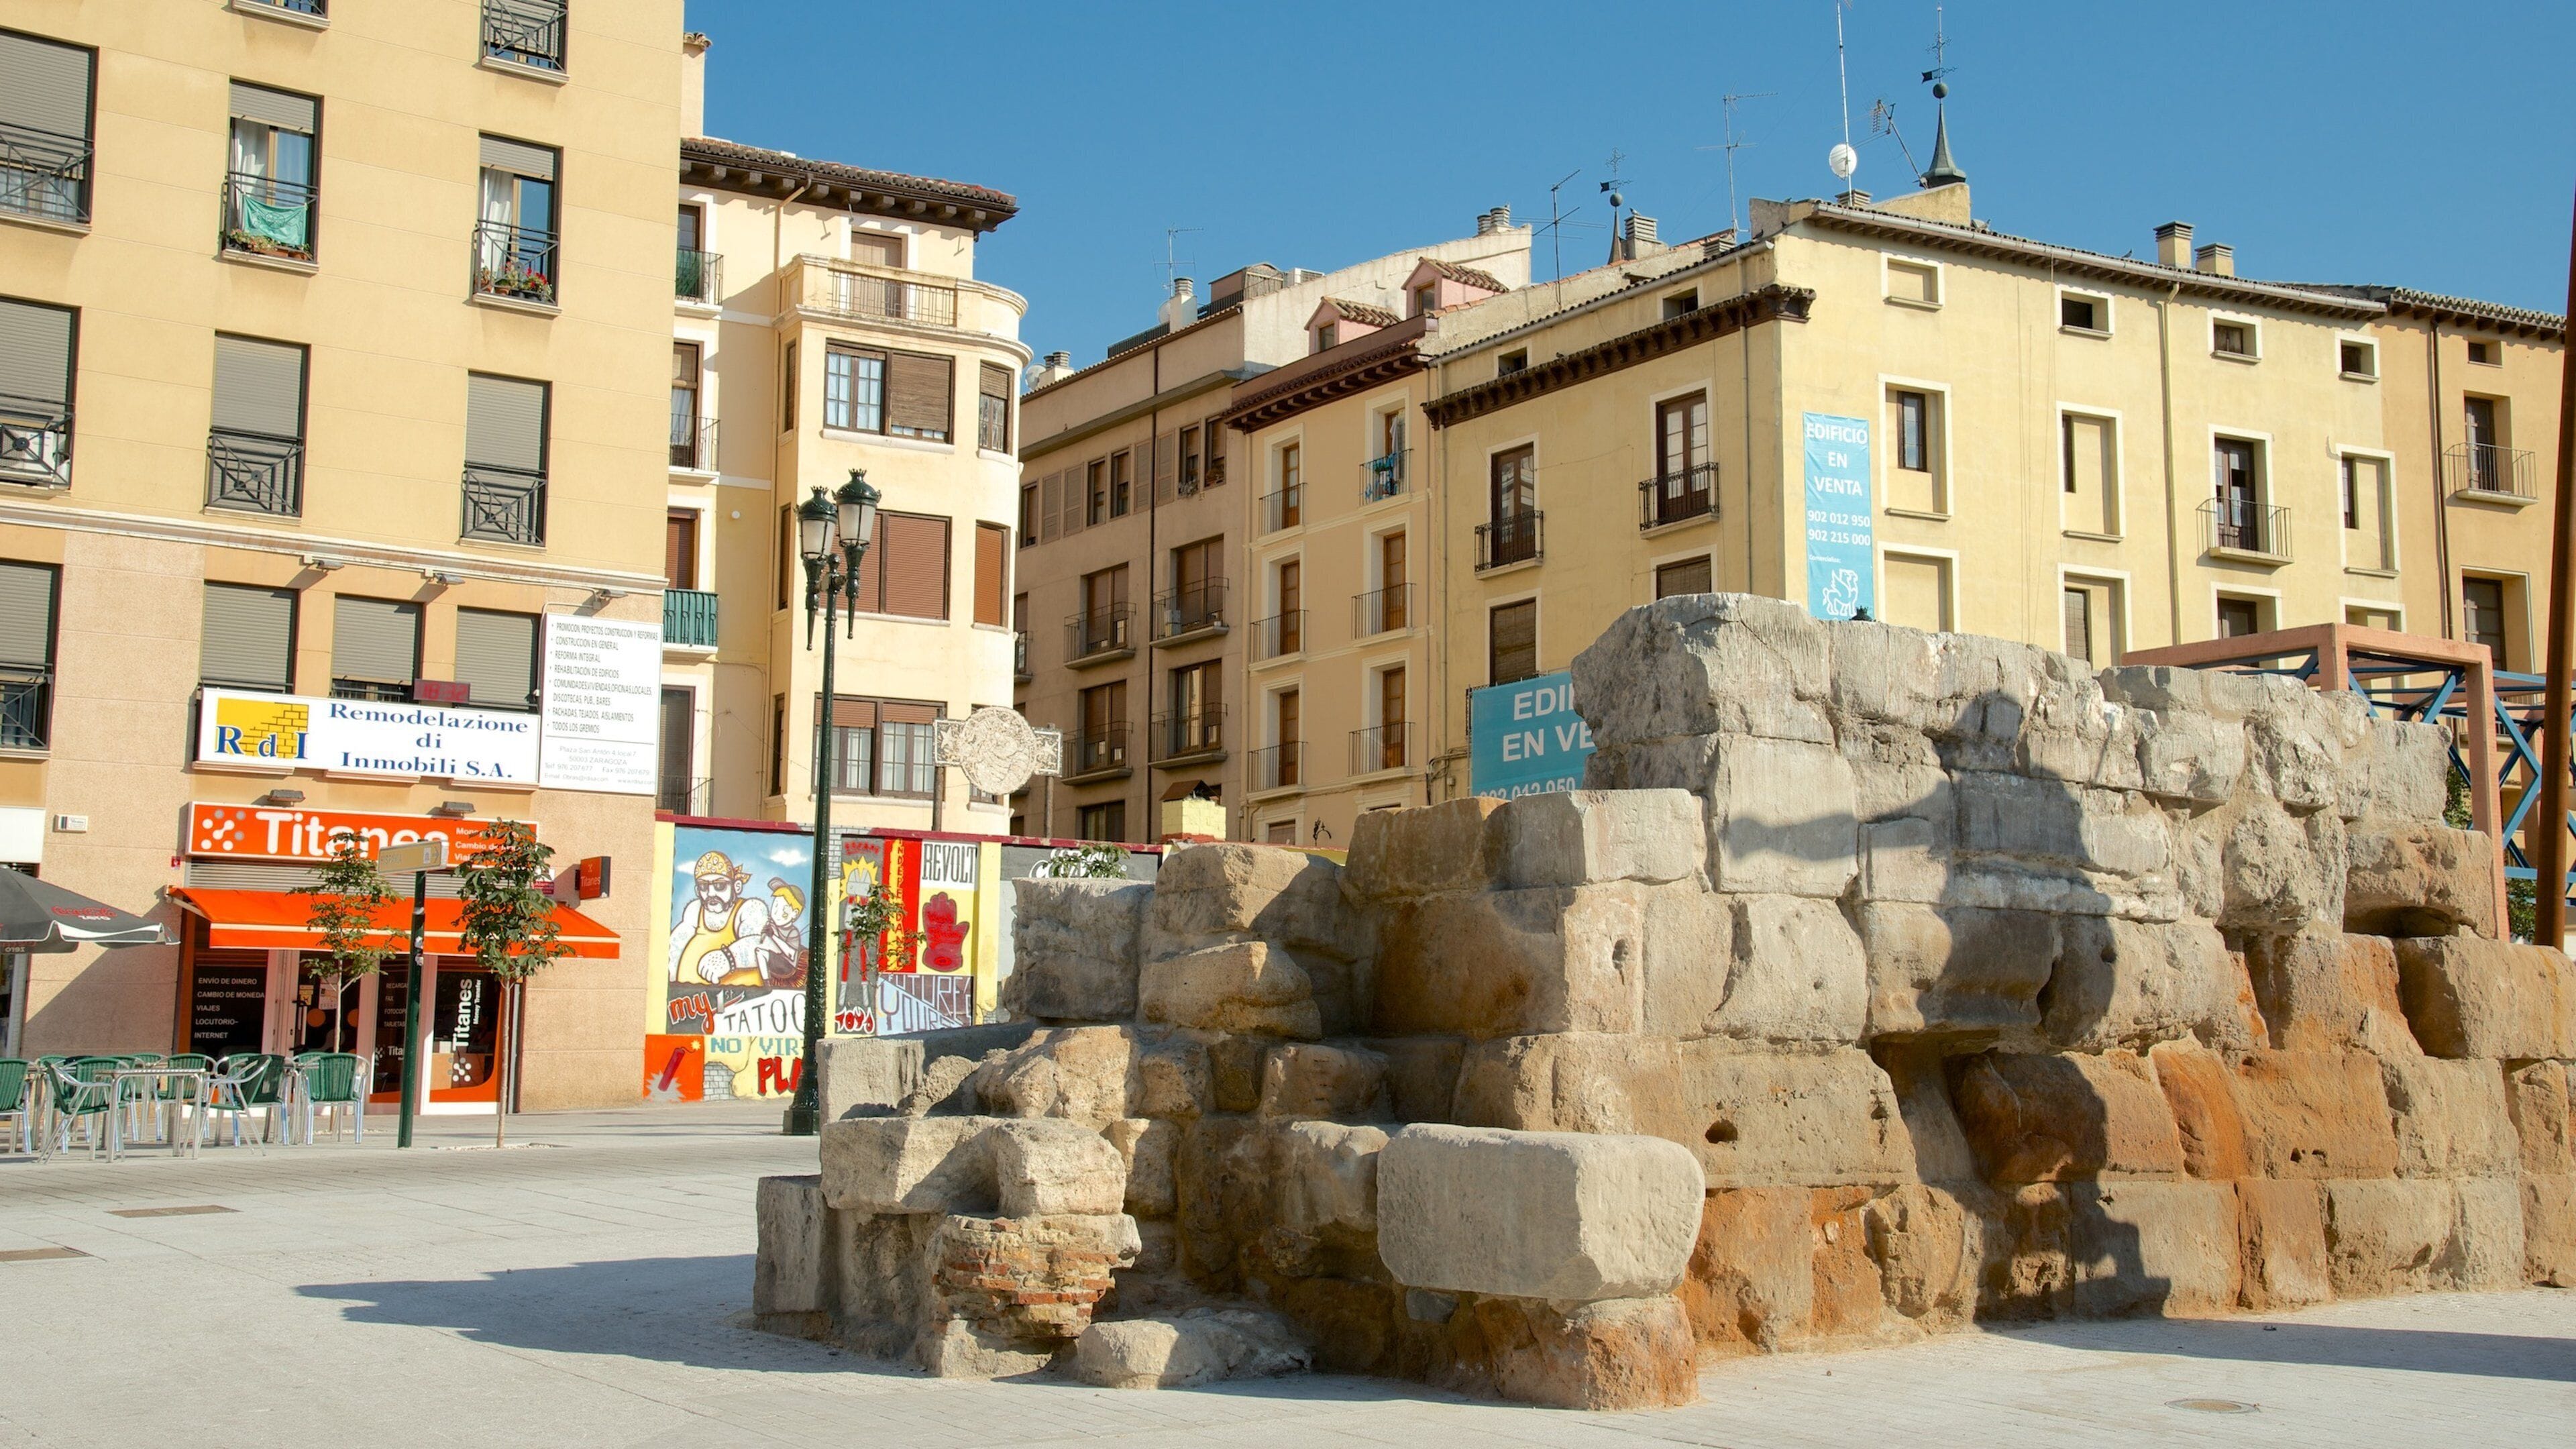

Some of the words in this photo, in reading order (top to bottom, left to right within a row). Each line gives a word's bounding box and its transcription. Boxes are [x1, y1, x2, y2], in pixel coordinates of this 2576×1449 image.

[1806, 422, 1868, 445] EDIFICIO
[1828, 451, 1847, 468] EN
[1814, 475, 1863, 496] VENTA
[1808, 510, 1827, 523] 902
[1829, 513, 1849, 525] 012
[1851, 515, 1870, 527] 950
[1808, 529, 1827, 542] 902
[1830, 531, 1849, 544] 215
[1851, 533, 1871, 546] 000
[555, 637, 590, 648] CONSTRUCCION
[592, 640, 598, 648] EN
[599, 641, 619, 651] GENERAL
[637, 631, 658, 641] REFORMAS
[555, 650, 577, 661] REFORMA
[578, 653, 601, 663] INTEGRAL
[554, 664, 591, 676] REHABILITACION
[592, 668, 598, 677] DE
[596, 696, 611, 706] BARES
[328, 702, 529, 734] Remodelazione
[552, 721, 568, 731] TODOS
[569, 723, 578, 732] LOS
[416, 733, 441, 749] di
[1503, 729, 1545, 762] EN
[1555, 720, 1596, 752] VE
[341, 751, 456, 775] Inmobili
[466, 760, 513, 778] S.A.
[589, 757, 627, 765] ZARAGOZA
[455, 841, 486, 850] Cambio
[922, 843, 977, 883] REVOLT
[581, 876, 601, 888] Titanes
[198, 977, 219, 985] ENVÍO
[474, 979, 482, 1004] Transfer
[452, 978, 473, 1051] Titanes
[473, 1004, 481, 1024] Money
[668, 991, 714, 1035] my
[388, 1046, 404, 1056] Tita
[710, 1037, 741, 1053] NO
[759, 1037, 804, 1056] VIR
